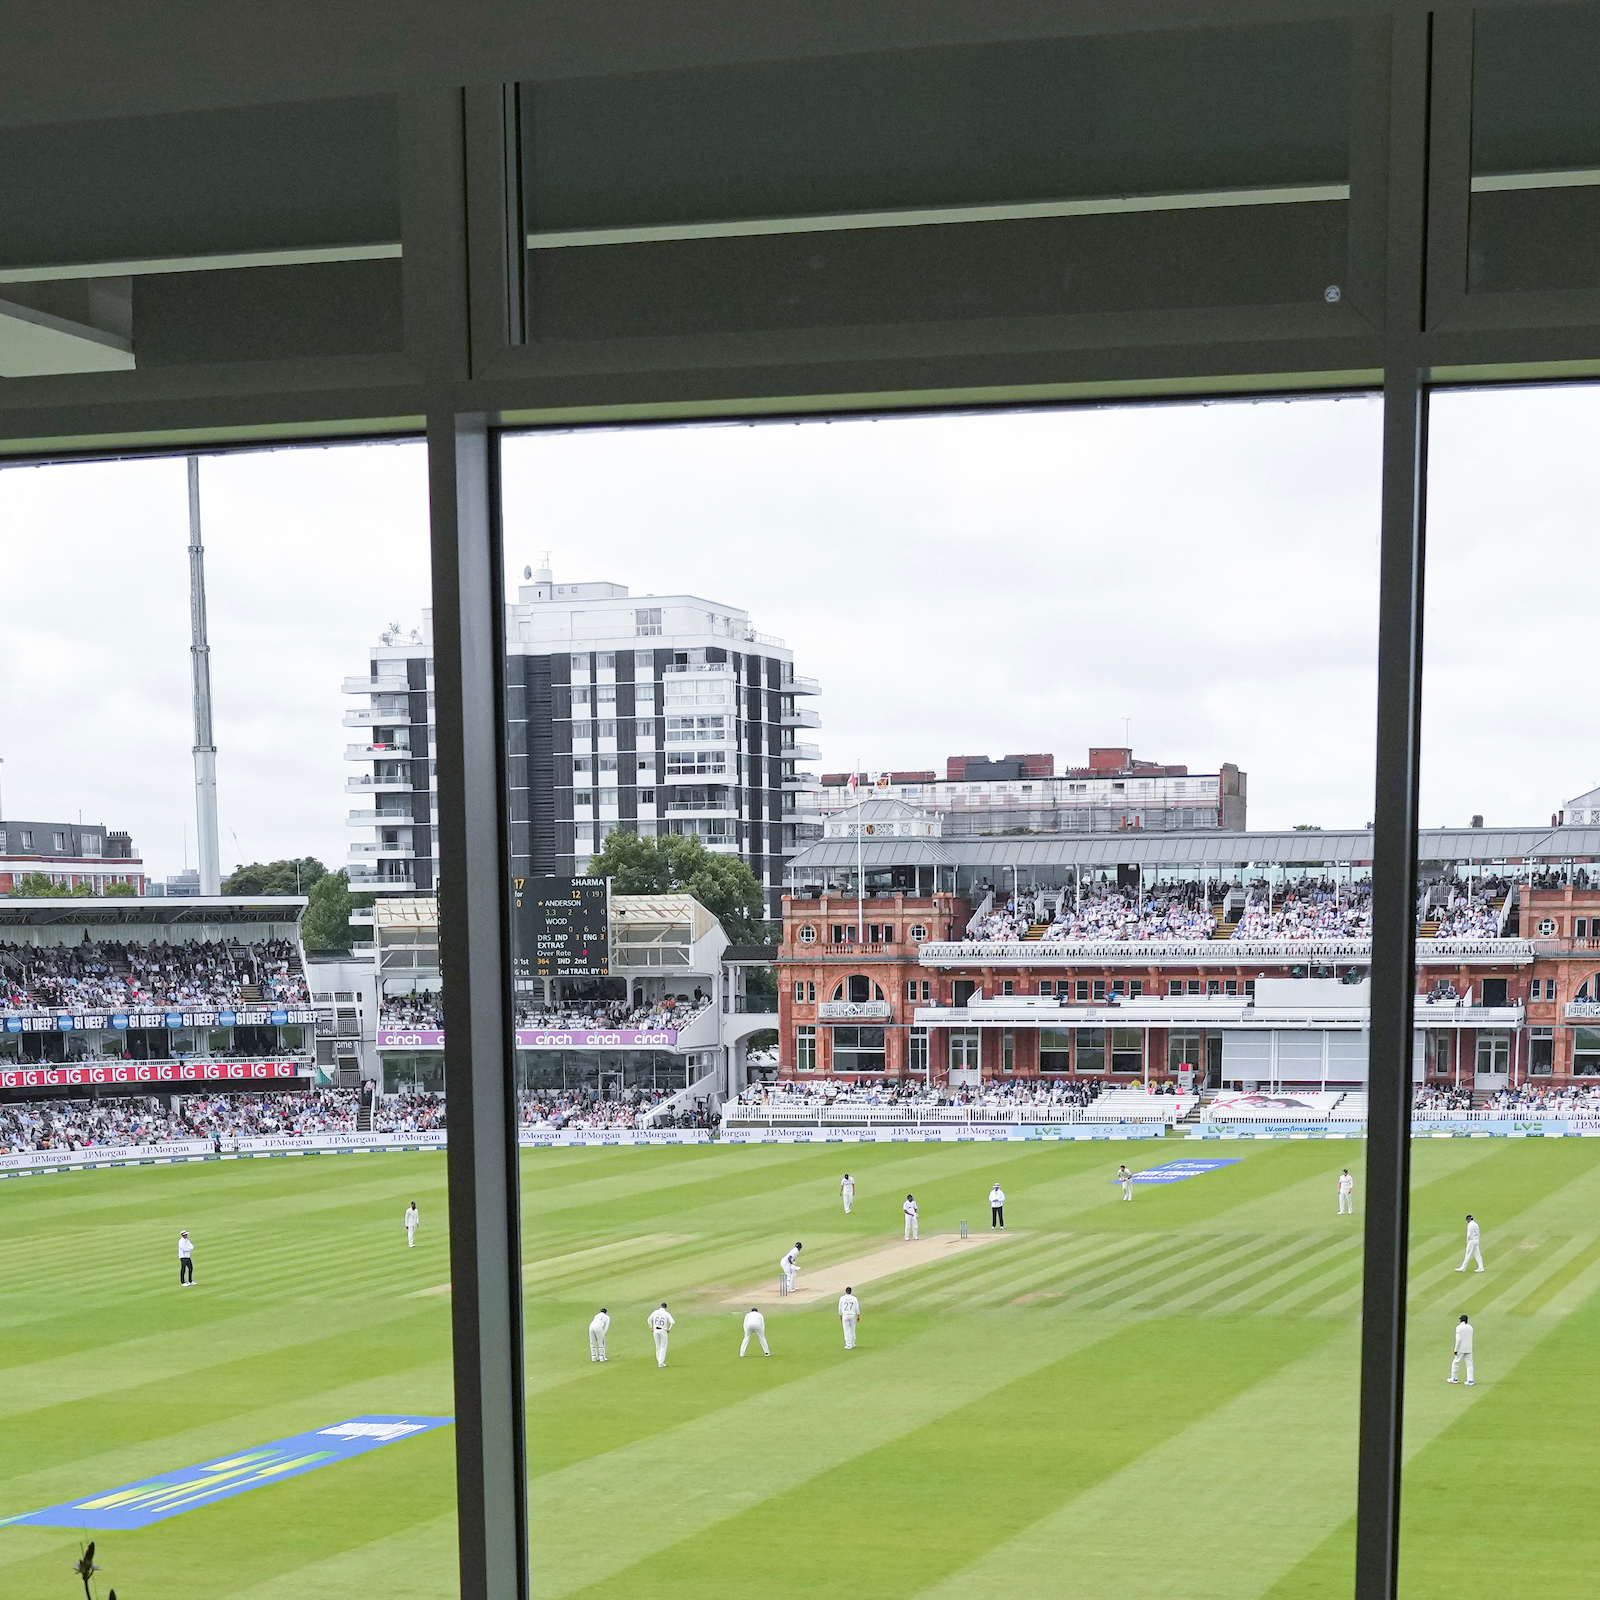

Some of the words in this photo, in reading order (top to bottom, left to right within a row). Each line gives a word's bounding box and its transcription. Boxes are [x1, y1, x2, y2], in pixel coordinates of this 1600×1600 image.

[514, 879, 525, 890] 17
[571, 890, 581, 899] 12
[516, 900, 521, 908] 0
[139, 1014, 161, 1027] DEEP
[385, 1032, 422, 1045] cinch
[536, 1032, 573, 1045] cinch
[586, 1031, 621, 1045] cinch
[634, 1031, 668, 1044] cinch
[204, 1065, 220, 1078] IG
[274, 1063, 291, 1077] IG
[1, 1073, 17, 1087] IG
[66, 1069, 82, 1084] IG
[764, 1128, 813, 1138] J.P.Morgan
[1265, 1125, 1328, 1133] LV.com/insurance
[391, 1133, 440, 1143] J.P.Morgan
[574, 1131, 621, 1141] J.P.Morgan
[844, 1302, 854, 1311] 27
[655, 1317, 665, 1326] 66
